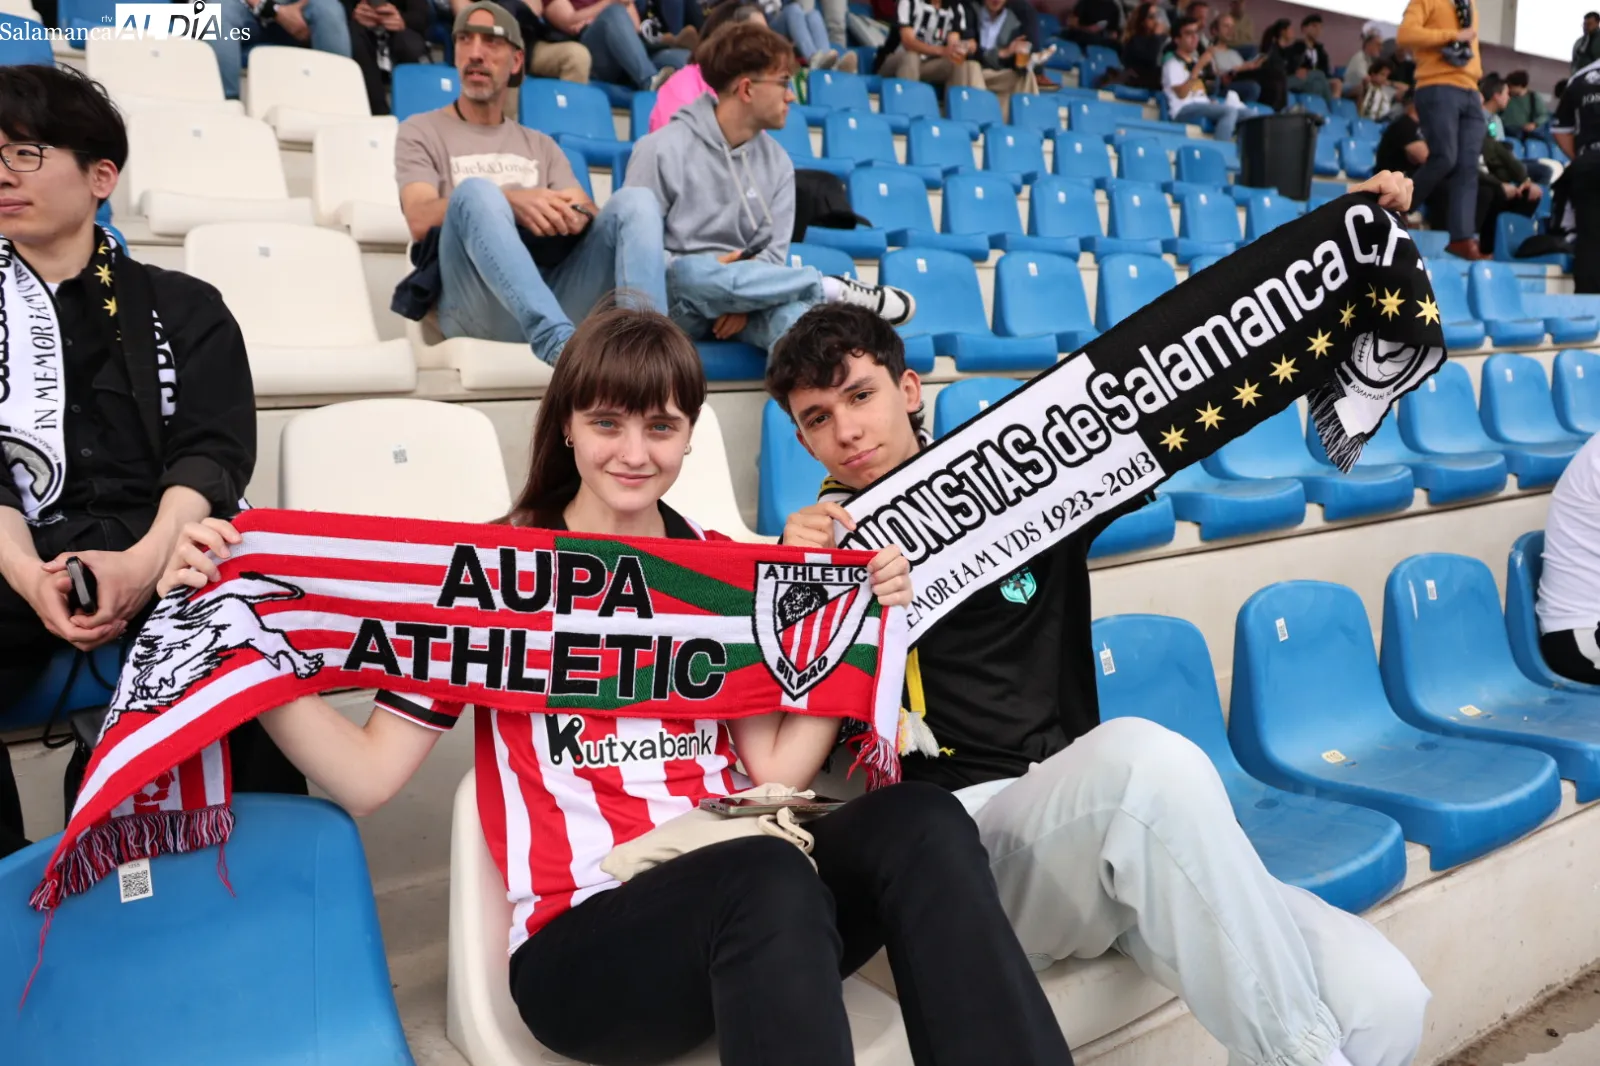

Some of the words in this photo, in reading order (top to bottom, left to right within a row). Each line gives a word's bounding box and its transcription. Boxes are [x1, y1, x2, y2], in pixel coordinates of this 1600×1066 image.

[1090, 239, 1350, 432] Salamanca
[993, 520, 1042, 560] VDS
[437, 544, 653, 617] AUPA
[763, 564, 868, 582] ATHLETIC
[344, 619, 725, 699] ATHLETIC
[776, 655, 828, 691] BILBAO
[544, 713, 713, 766] Kutxabank
